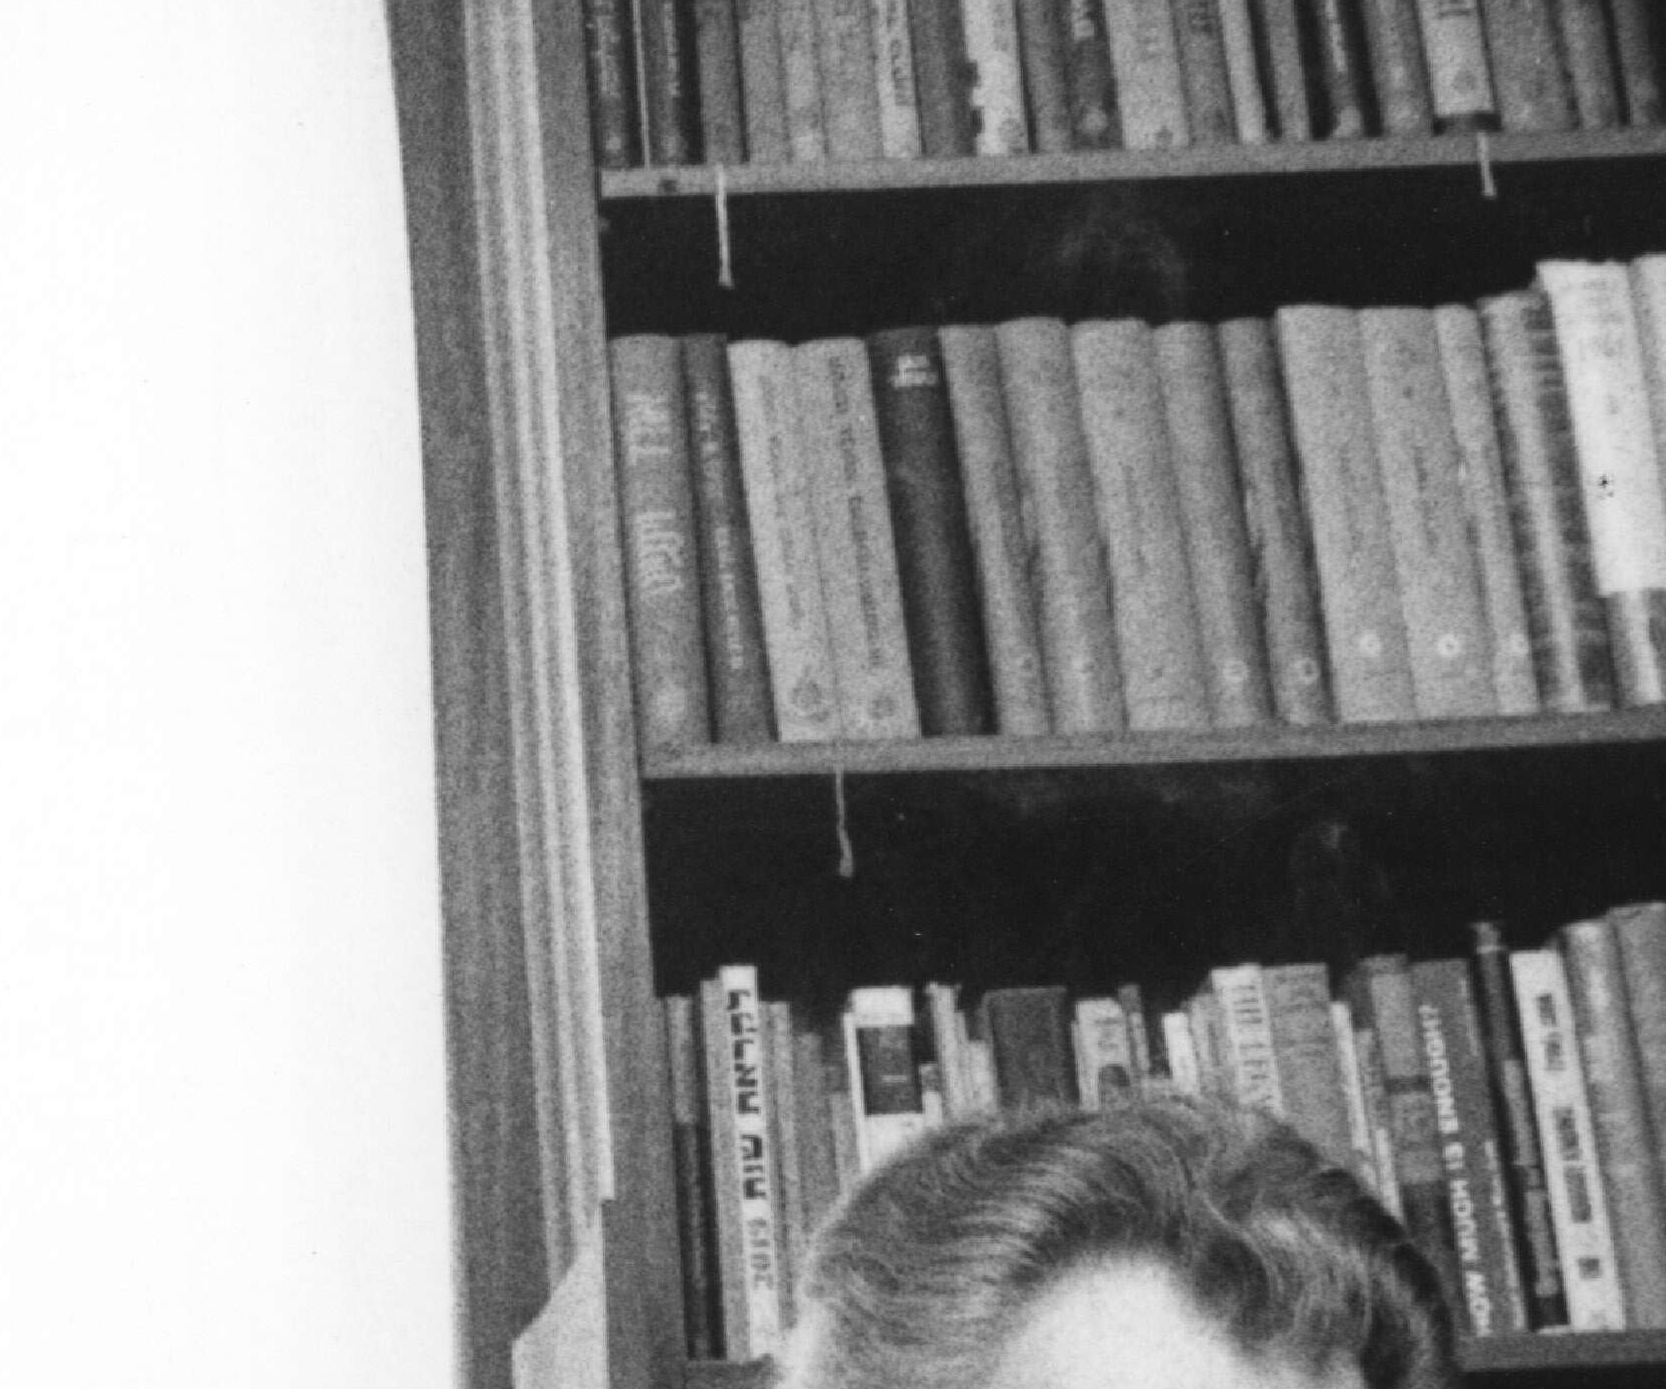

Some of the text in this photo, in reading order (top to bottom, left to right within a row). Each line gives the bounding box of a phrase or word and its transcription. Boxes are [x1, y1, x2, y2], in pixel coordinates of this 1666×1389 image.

[726, 988, 761, 1115] לקראת
[739, 1134, 767, 1201] שנת
[1419, 1003, 1492, 1338] HOW MUCH IS ENOUGH?
